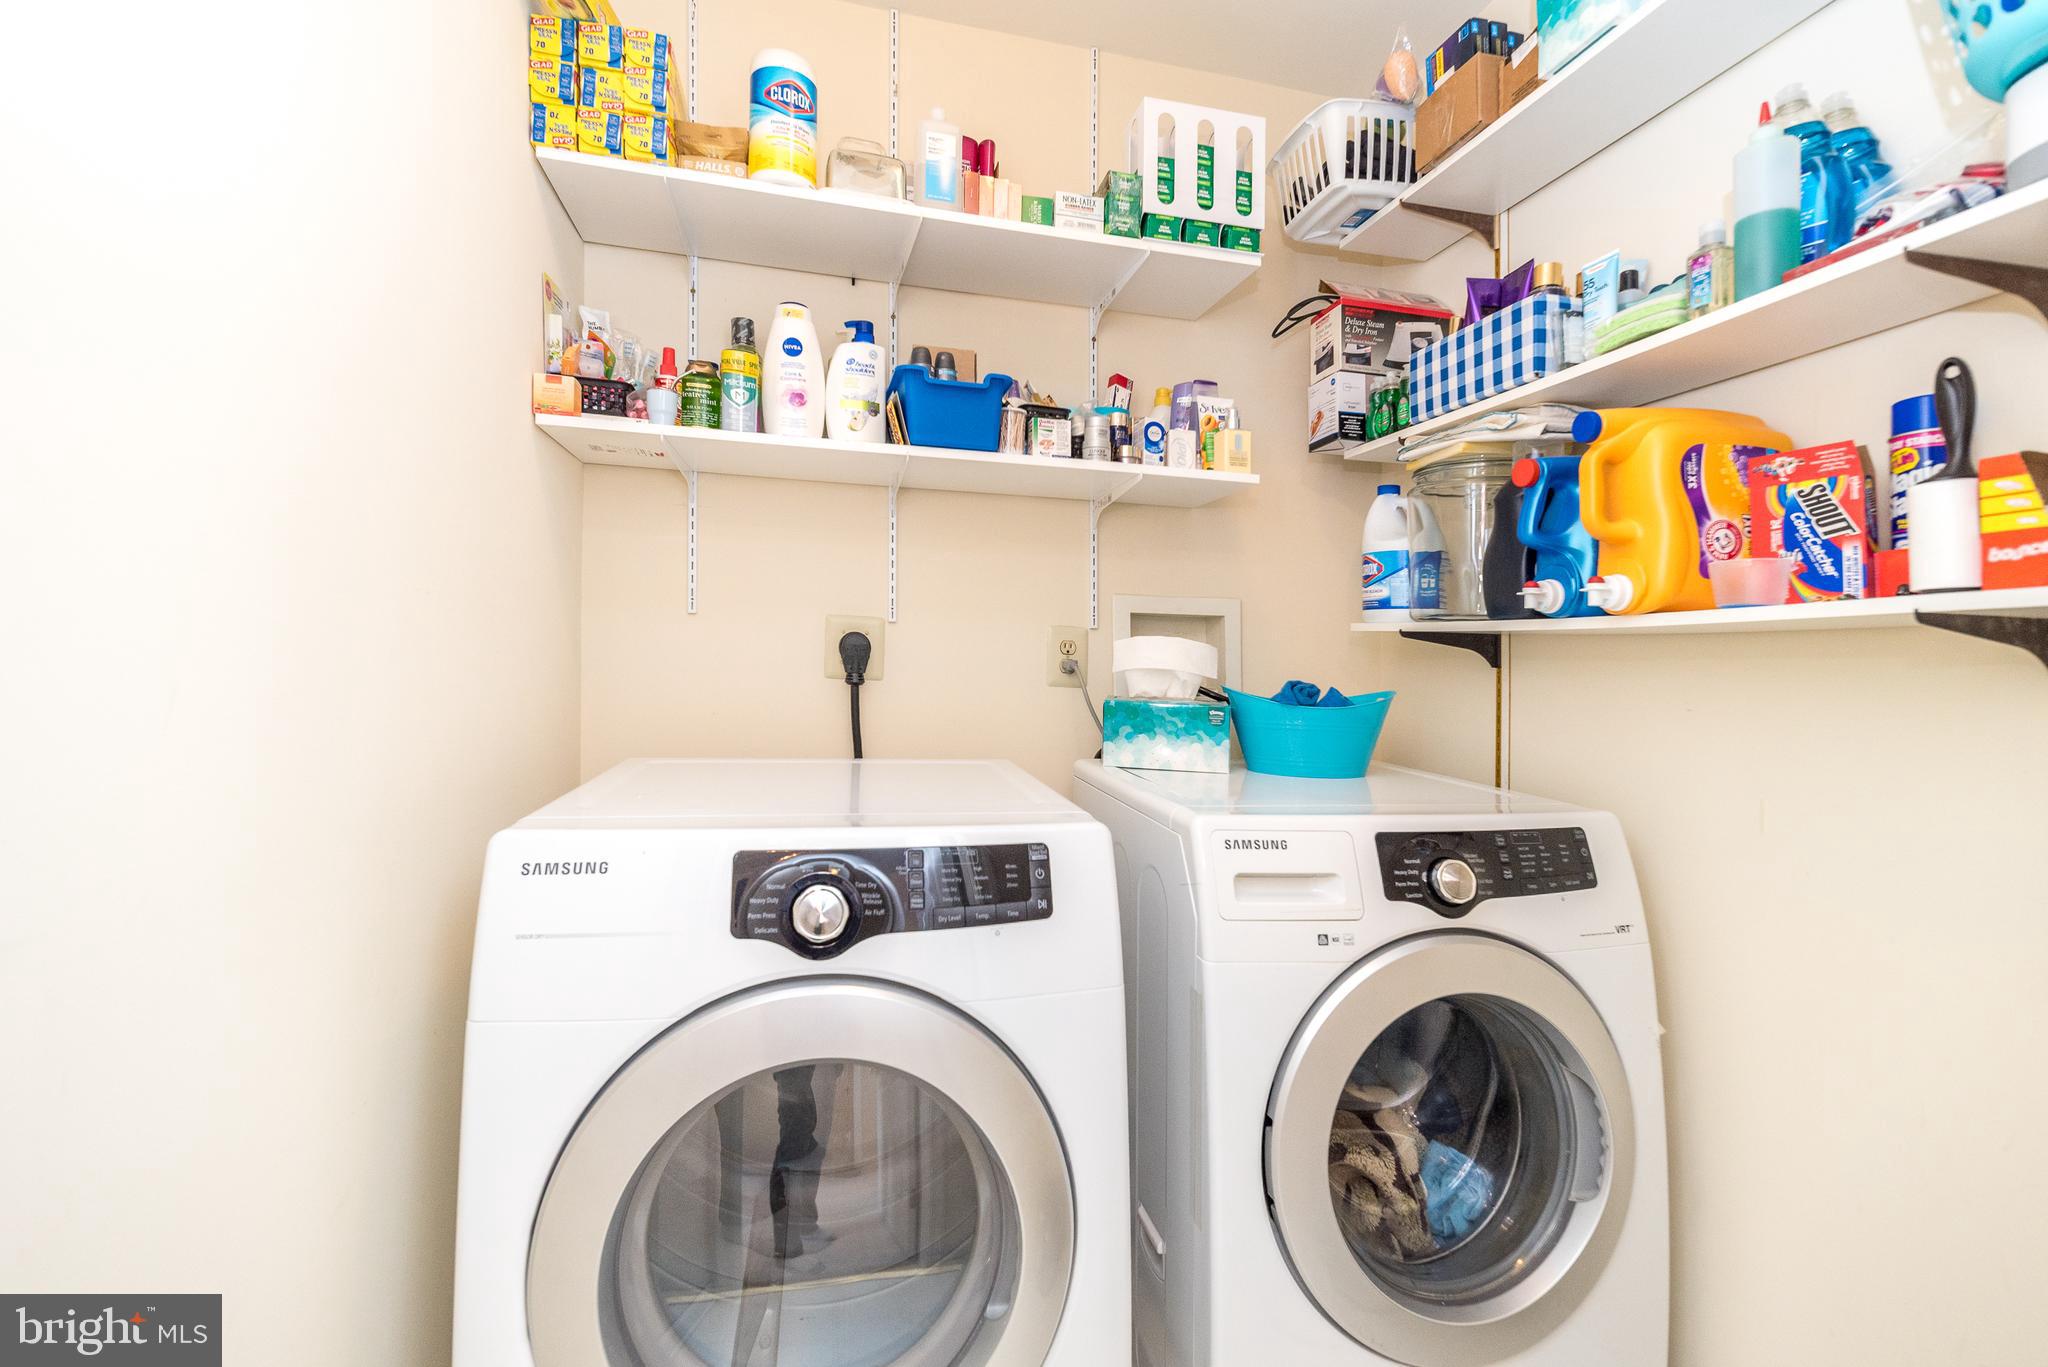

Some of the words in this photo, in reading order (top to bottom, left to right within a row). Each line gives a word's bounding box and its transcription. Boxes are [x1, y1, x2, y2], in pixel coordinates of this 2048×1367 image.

[770, 86, 810, 112] CLOROX
[696, 161, 730, 174] HALLS
[1345, 317, 1365, 326] Deluxe
[1367, 320, 1384, 328] Steam
[1353, 326, 1364, 335] Dry
[1687, 475, 1697, 488] 3X
[1797, 484, 1856, 536] SHOUT
[1790, 512, 1839, 578] ColorCatcher
[1224, 839, 1288, 851] SAMSUNG
[521, 861, 608, 875] SAMSUNG
